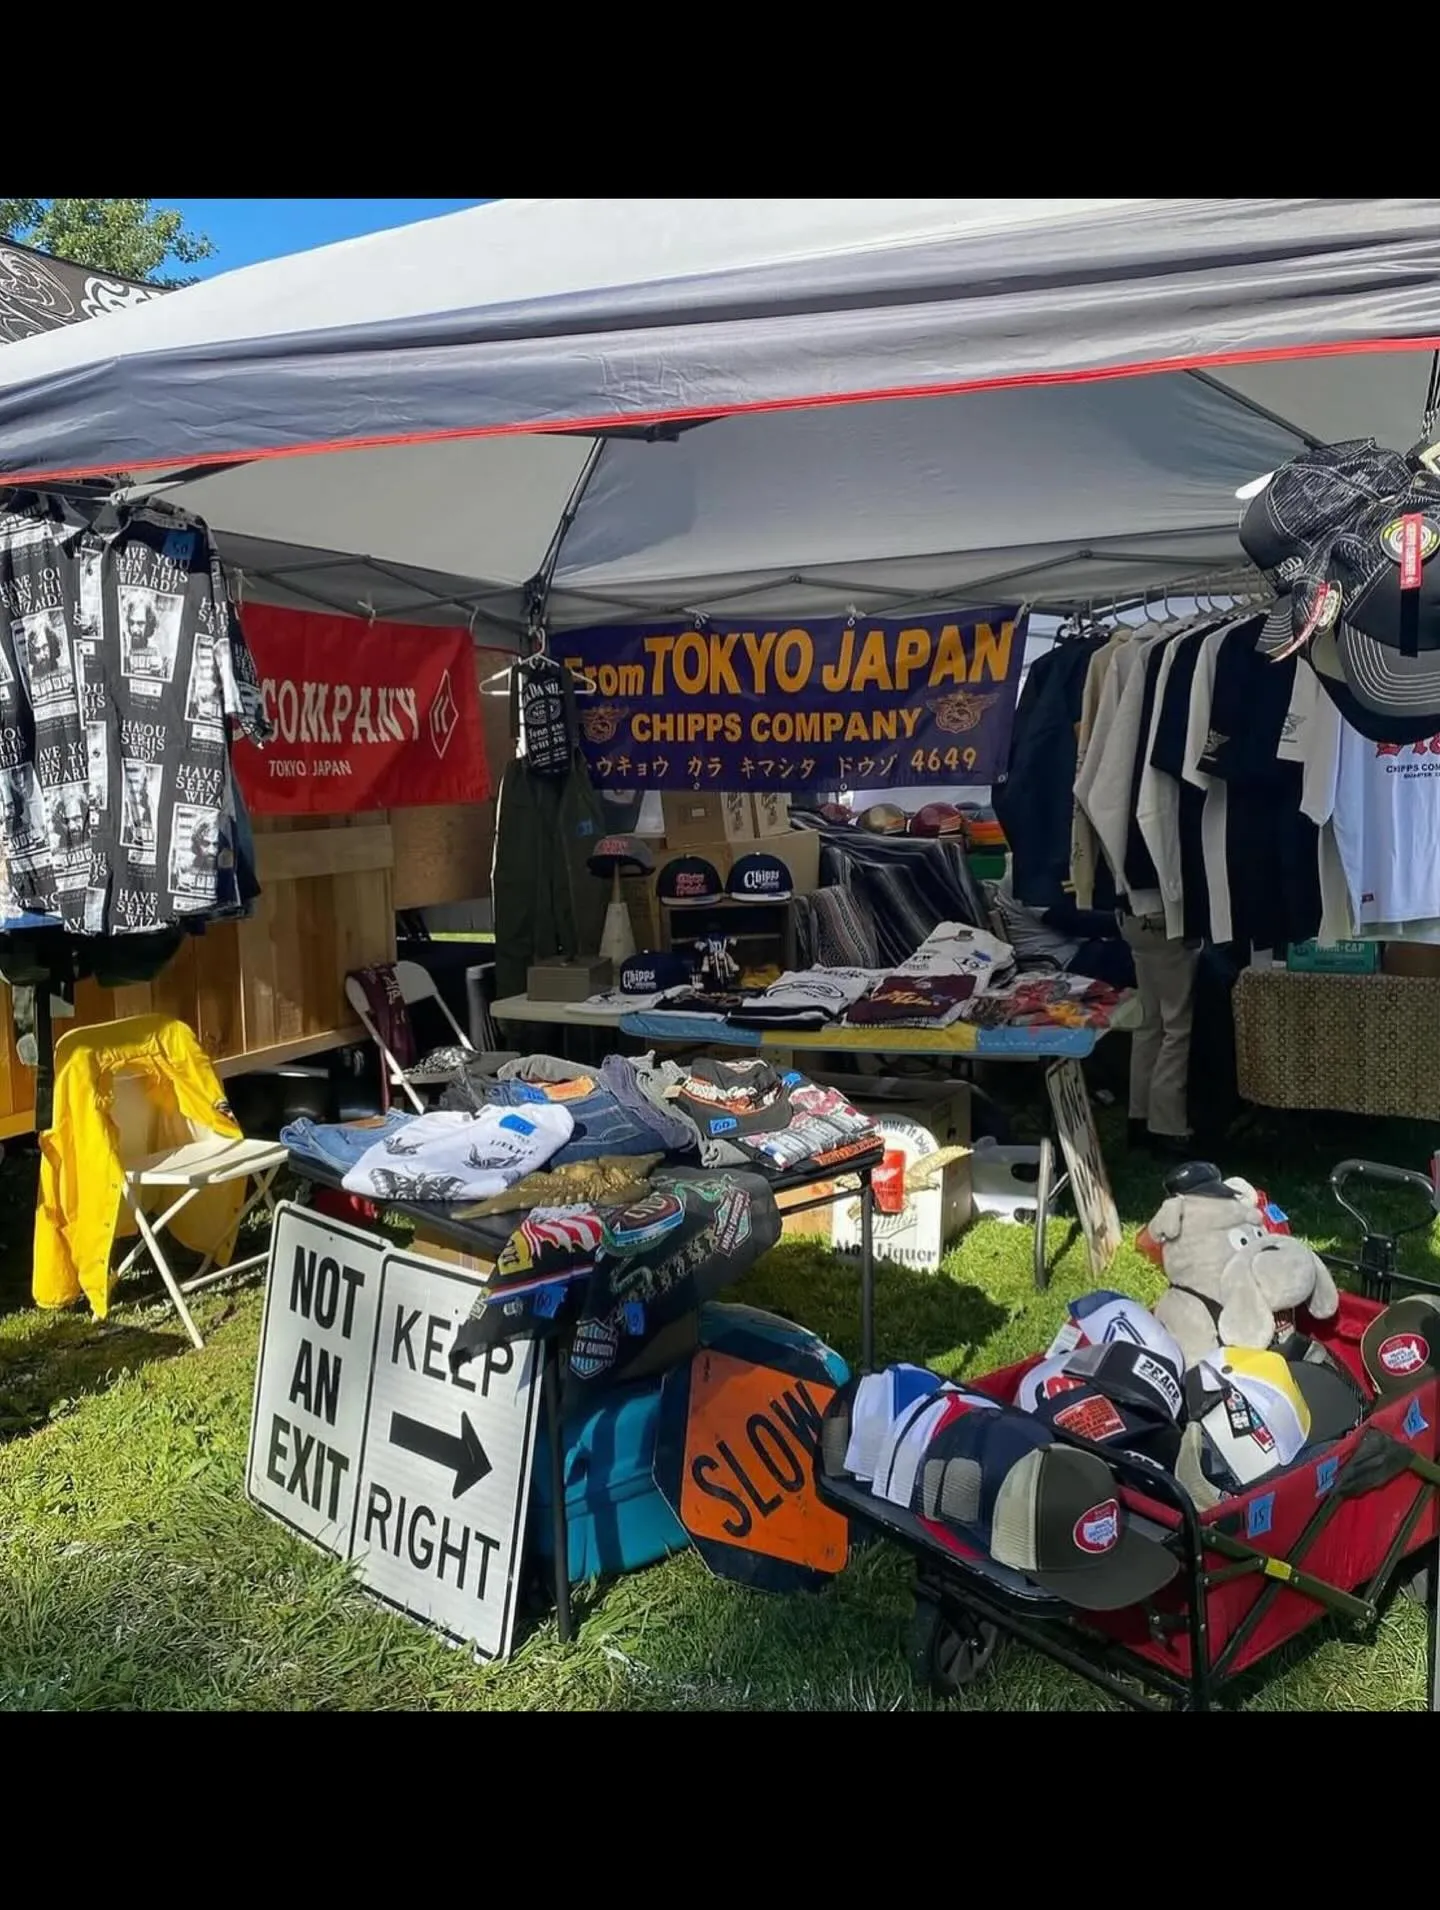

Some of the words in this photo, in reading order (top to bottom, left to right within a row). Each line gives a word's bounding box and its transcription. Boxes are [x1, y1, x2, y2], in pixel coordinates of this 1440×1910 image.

[151, 563, 189, 583] THIS
[644, 629, 813, 696] TOKYO
[822, 620, 1017, 692] JAPAN
[261, 678, 420, 745] COMPANY
[631, 712, 743, 744] CHIPPS
[750, 707, 922, 743] COMPANY
[178, 763, 222, 782] HAVE
[269, 759, 307, 777] TOKYO
[312, 759, 352, 777] JAPAN
[687, 754, 722, 777] カラ
[911, 746, 977, 771] 4649
[175, 776, 218, 794] SEEN
[116, 901, 157, 917] SEEN
[118, 888, 159, 906] HAVE
[289, 1244, 366, 1340] NOT
[289, 1338, 342, 1428] AN
[1140, 1359, 1180, 1405] PEACE
[266, 1412, 350, 1524] EXIT
[691, 1380, 823, 1538] SLOW
[364, 1481, 501, 1602] RIGHT
